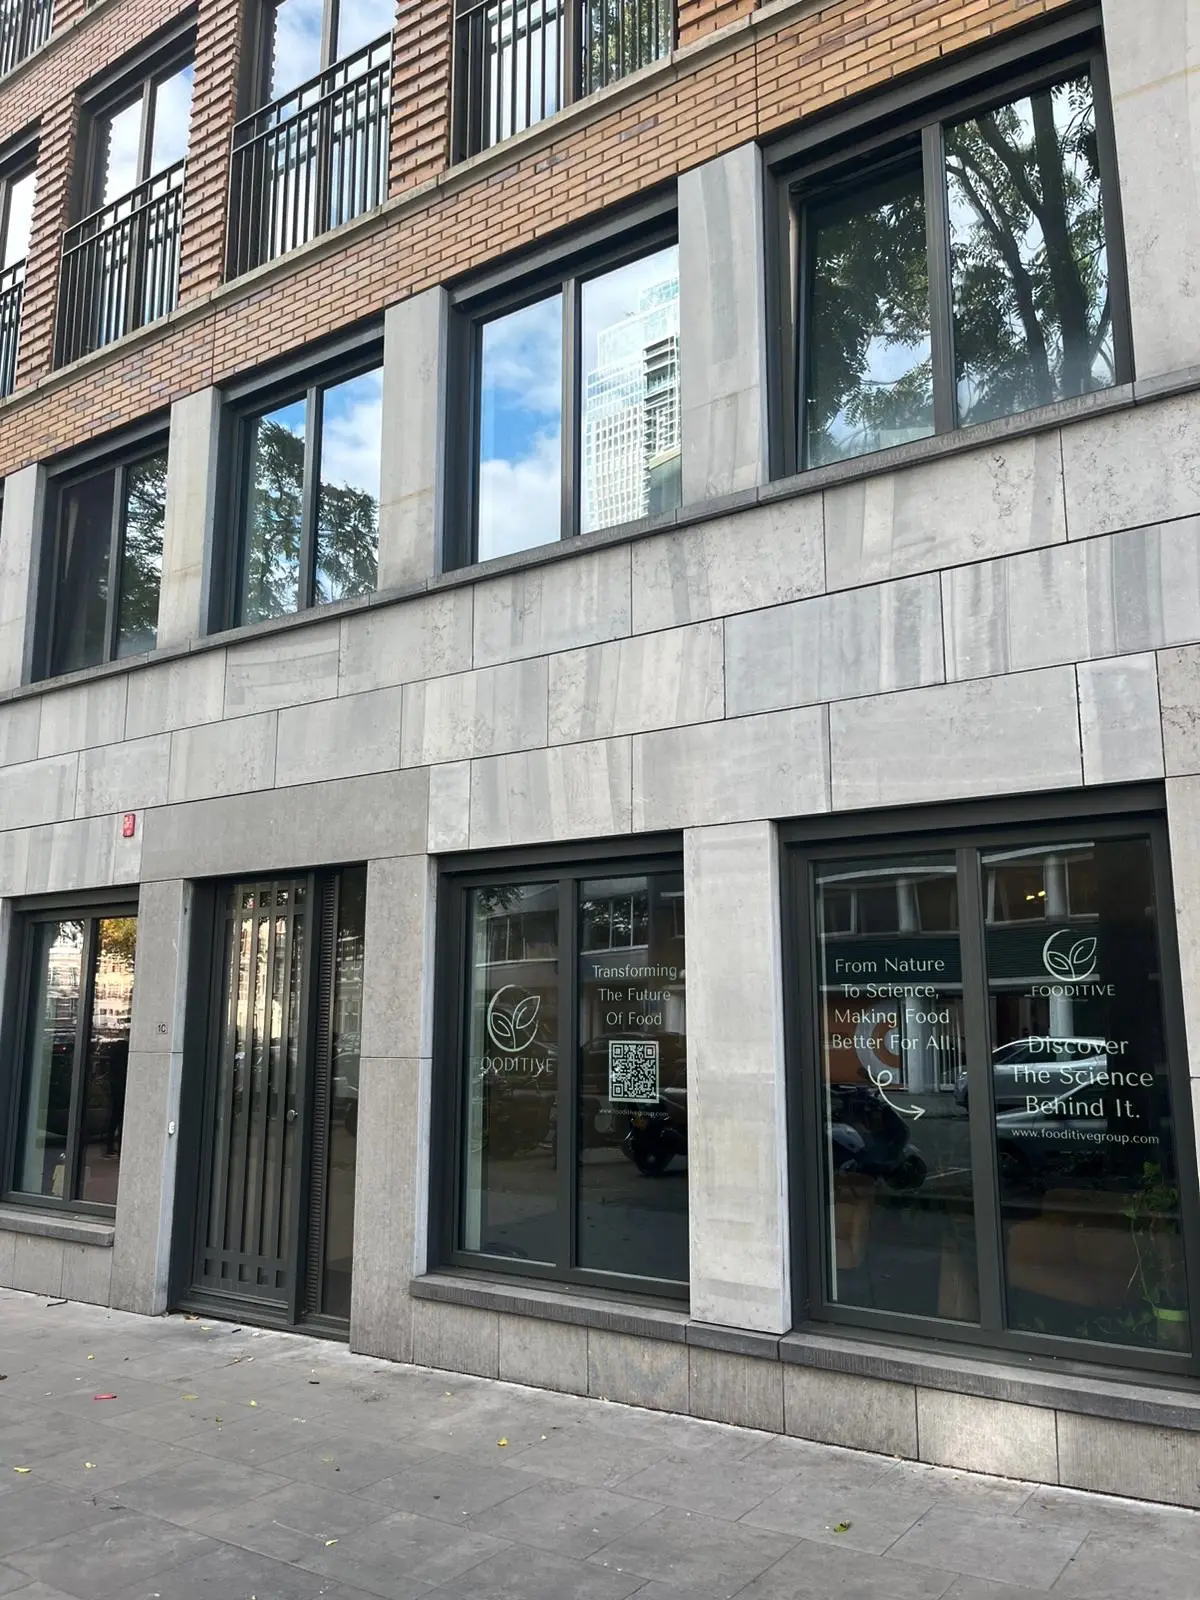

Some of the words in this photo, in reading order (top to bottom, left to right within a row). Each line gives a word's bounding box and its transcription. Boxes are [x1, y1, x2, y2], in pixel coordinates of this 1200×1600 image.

[592, 963, 677, 981] Transforming
[835, 959, 877, 973] From
[885, 958, 945, 972] Nature
[598, 986, 623, 1001] The
[628, 986, 672, 1001] Future
[841, 983, 860, 998] To
[866, 983, 939, 999] Science,
[1031, 984, 1116, 997] FOODITIVE
[606, 1011, 624, 1026] Of
[628, 1011, 662, 1026] Food
[835, 1009, 897, 1028] Making
[905, 1008, 950, 1024] Food
[832, 1034, 883, 1049] Better
[890, 1034, 919, 1050] For
[926, 1035, 955, 1050] All.
[1028, 1036, 1129, 1055] Discover
[471, 1056, 556, 1073] OODITIVE
[1011, 1065, 1050, 1084] The
[1059, 1066, 1154, 1087] Science
[1026, 1095, 1104, 1117] Behind
[1116, 1098, 1141, 1118] It.
[1011, 1128, 1160, 1145] www.fooditivegroup.com
